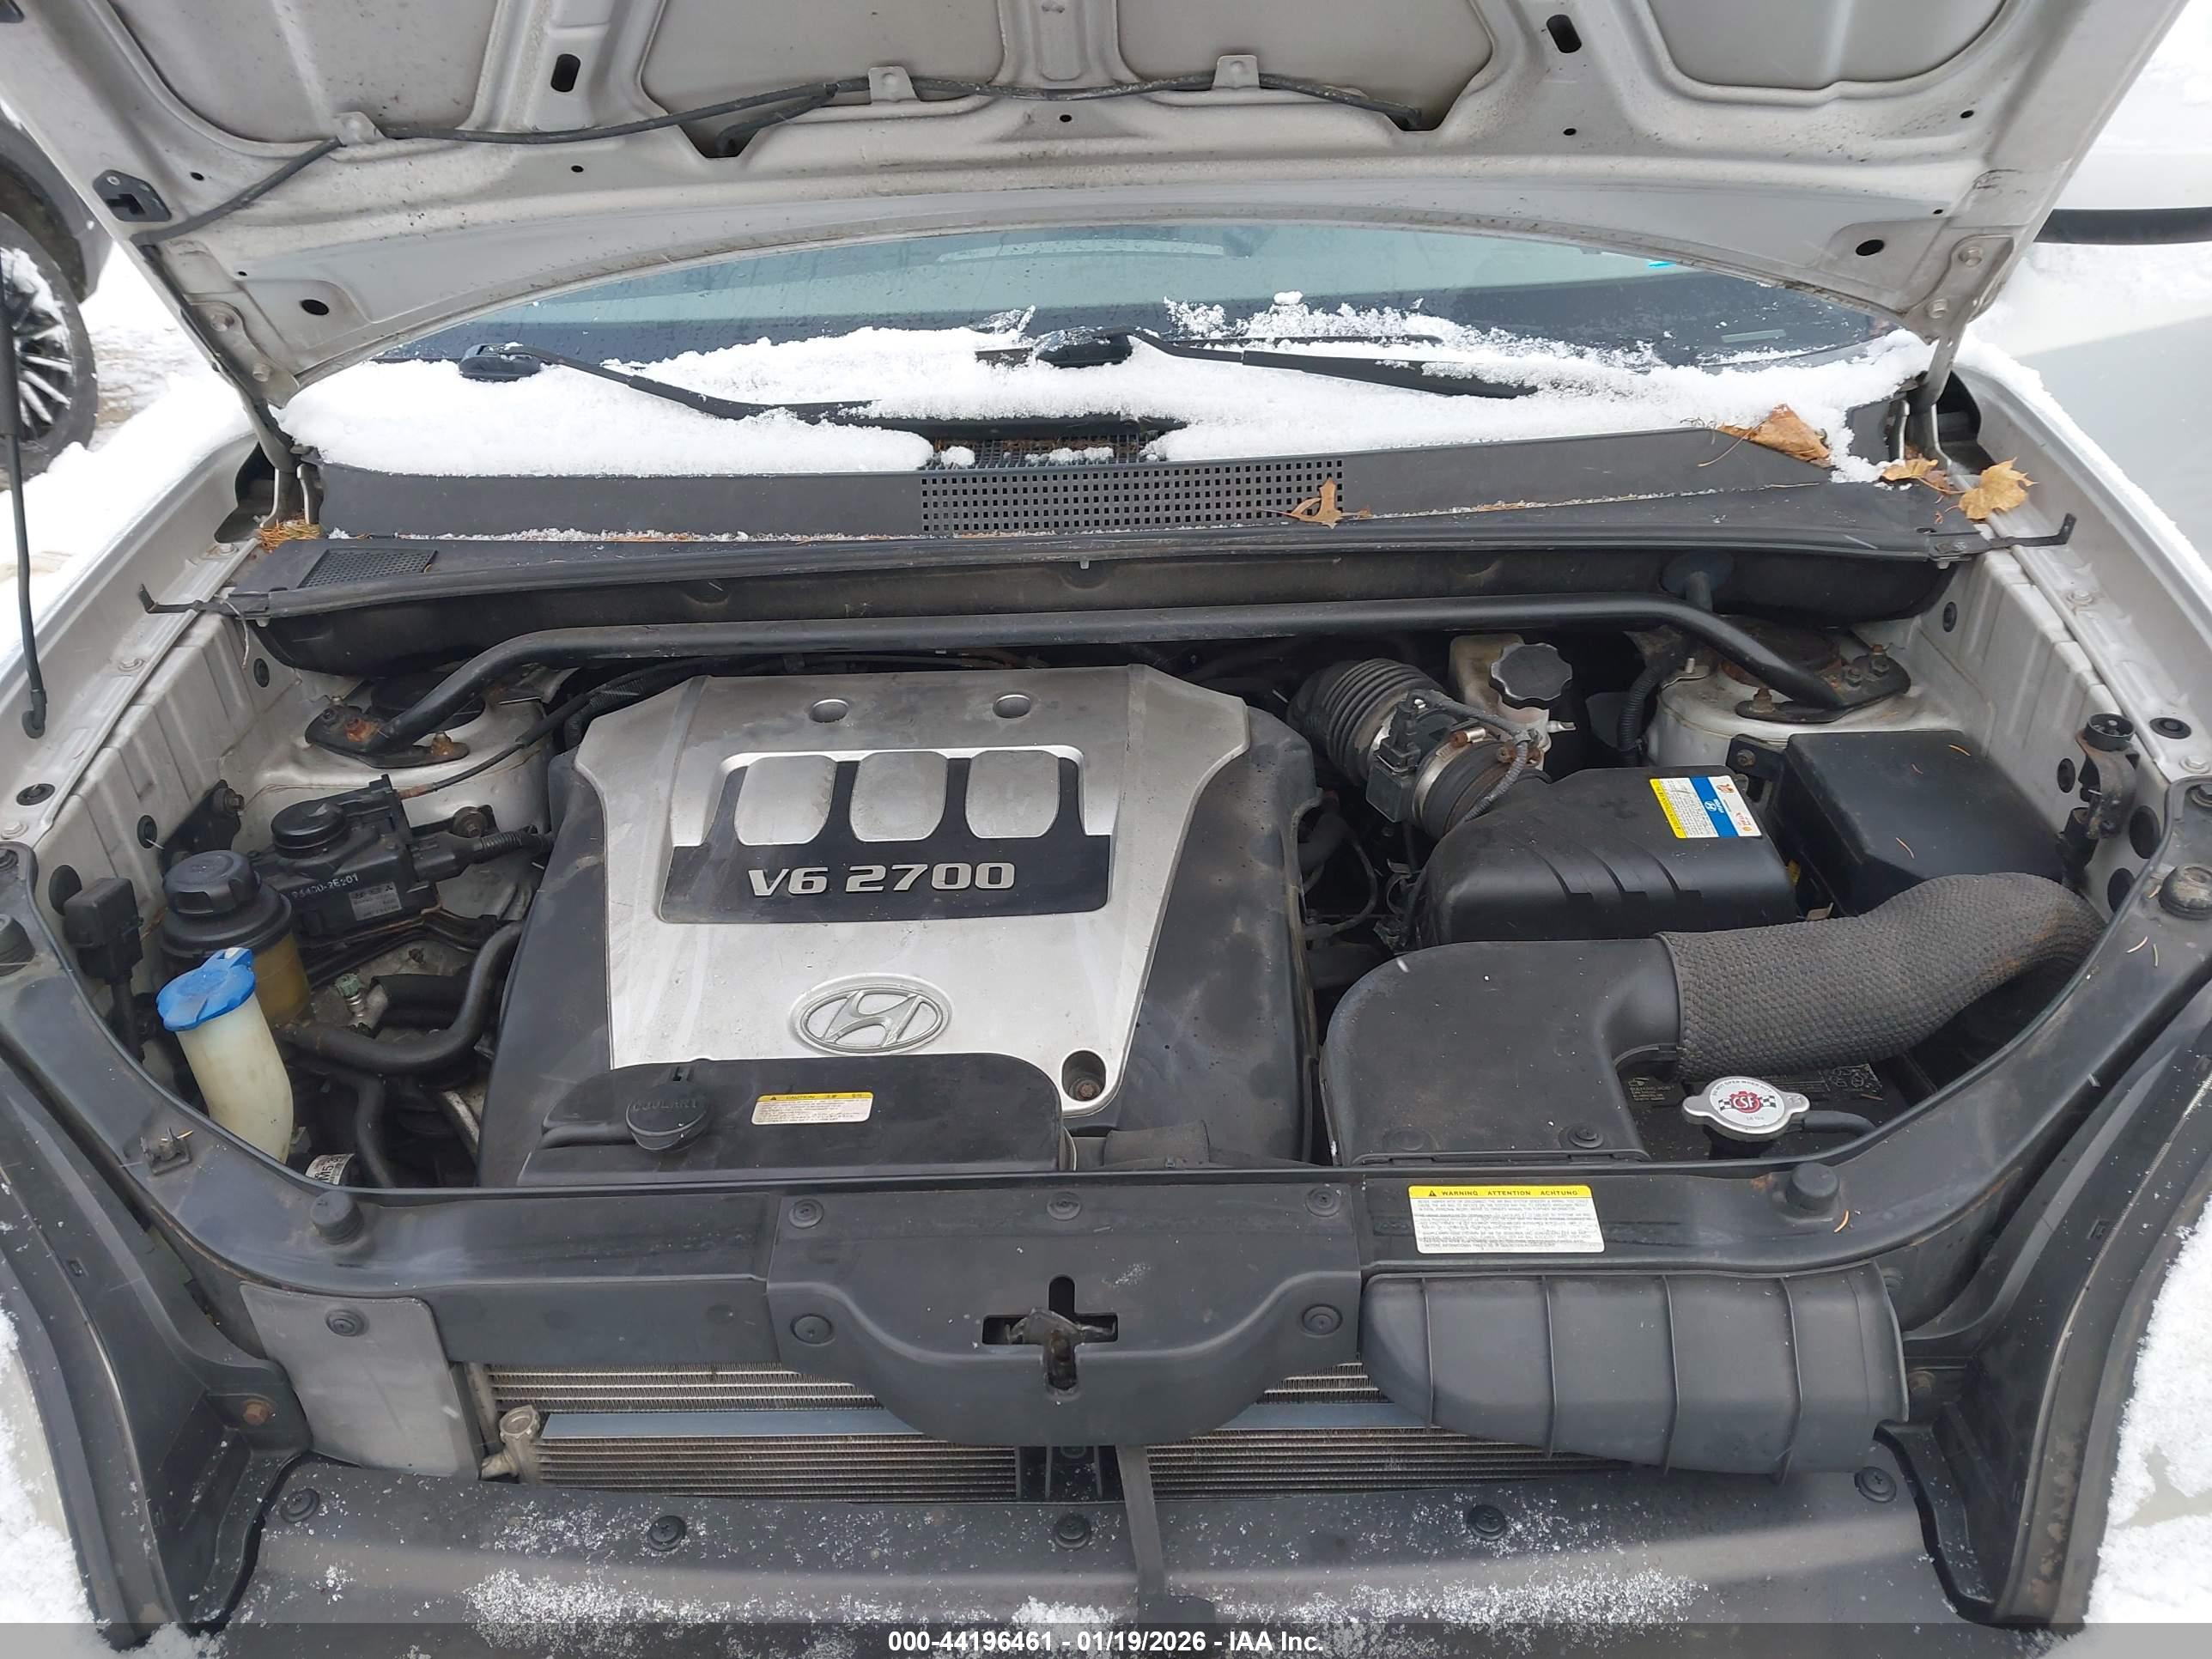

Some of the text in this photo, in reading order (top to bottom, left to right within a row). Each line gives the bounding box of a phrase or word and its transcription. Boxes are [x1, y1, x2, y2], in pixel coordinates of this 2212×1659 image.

[748, 862, 1017, 896] V6 2700
[1732, 1096, 1754, 1109] CSF
